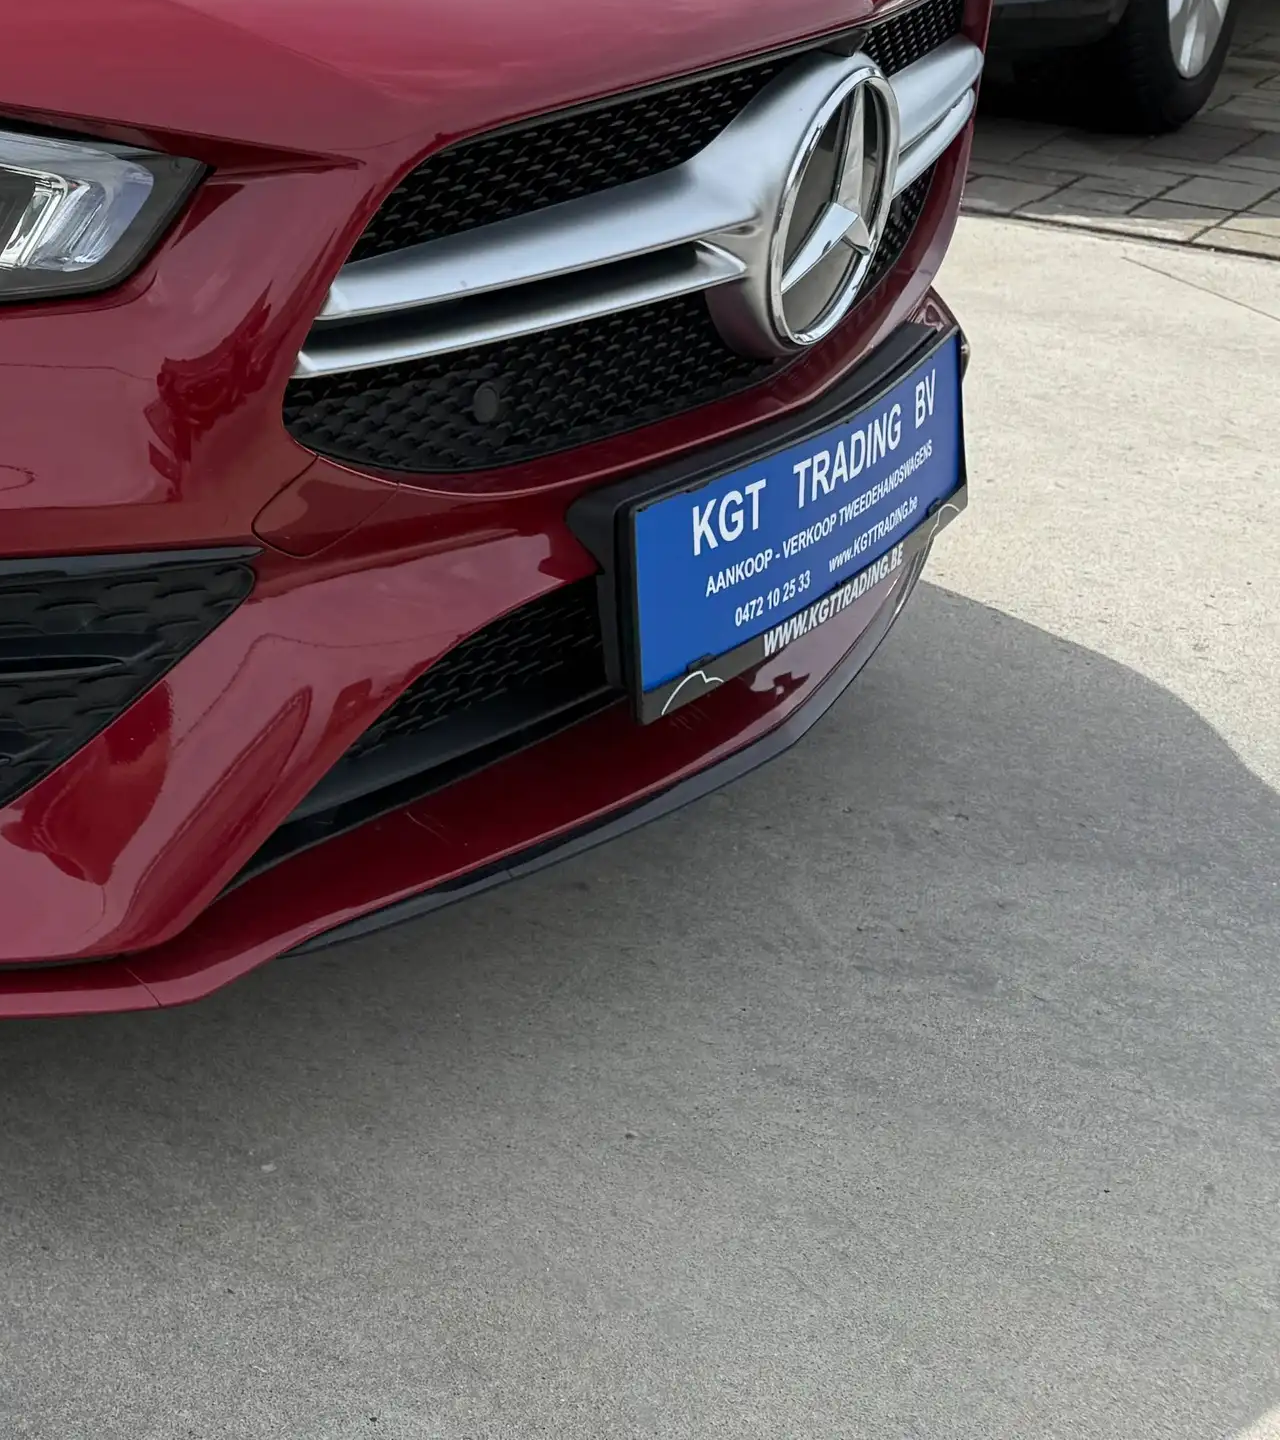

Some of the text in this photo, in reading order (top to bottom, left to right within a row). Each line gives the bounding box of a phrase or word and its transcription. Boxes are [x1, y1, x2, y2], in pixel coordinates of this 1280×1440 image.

[692, 368, 936, 556] KGT TRADING BV
[705, 547, 774, 597] AANKOOP
[782, 512, 837, 559] VERKOOP
[839, 438, 933, 527] TWEEDEHANDSWAGENS
[735, 495, 918, 627] 0472 10 25 33 www.KGTTRADING.be
[763, 541, 905, 657] WWW.KGTTRADING.BE
